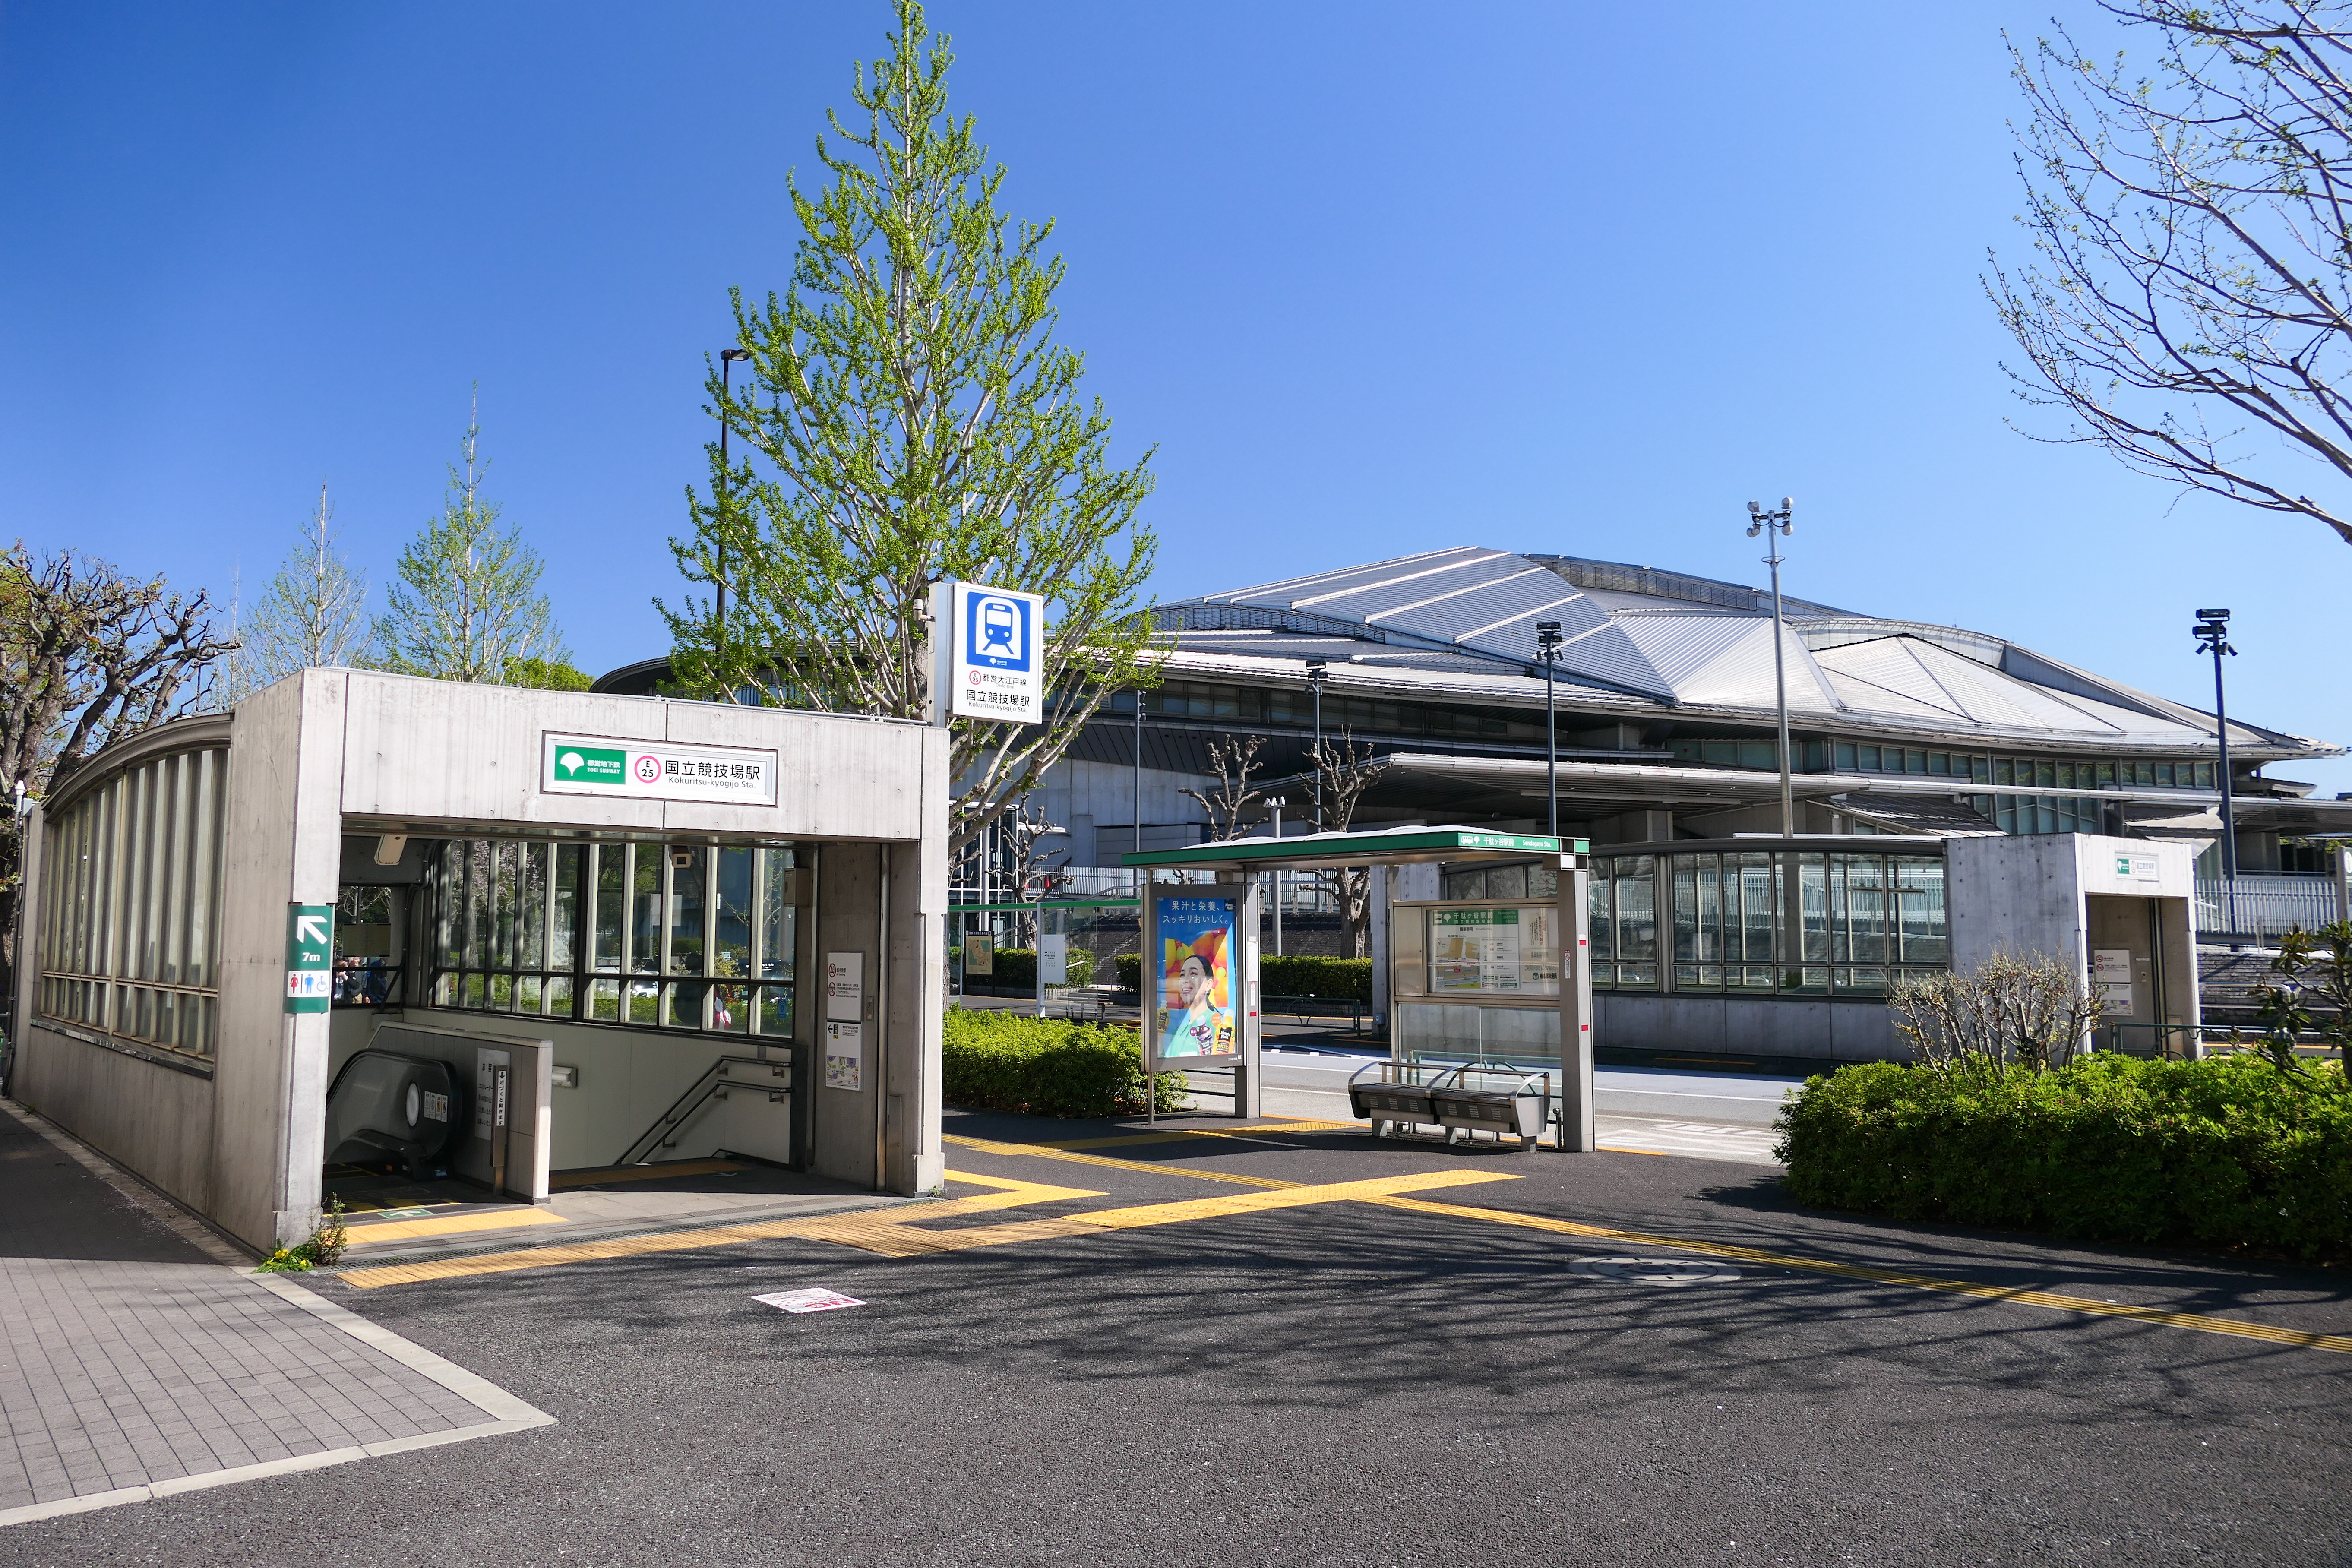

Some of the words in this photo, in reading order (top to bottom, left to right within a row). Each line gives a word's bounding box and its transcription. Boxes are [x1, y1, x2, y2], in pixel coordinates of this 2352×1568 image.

[983, 674, 1027, 686] 都営大江戸線
[967, 689, 1029, 707] 国立競技場駅
[968, 702, 1016, 712] Kokuritsu-kyogijo
[587, 759, 620, 768] 都営地下鉄
[641, 769, 654, 777] 25
[665, 760, 759, 780] 国立競技場駅
[669, 776, 739, 789] Kokuritsu-kyogijo
[741, 781, 756, 789] Sta.
[1522, 840, 1543, 848] Sendagaya
[1172, 901, 1220, 911] 果汁と栄養、
[1163, 915, 1228, 924] スッキリおいしく。
[302, 952, 320, 962] 7m
